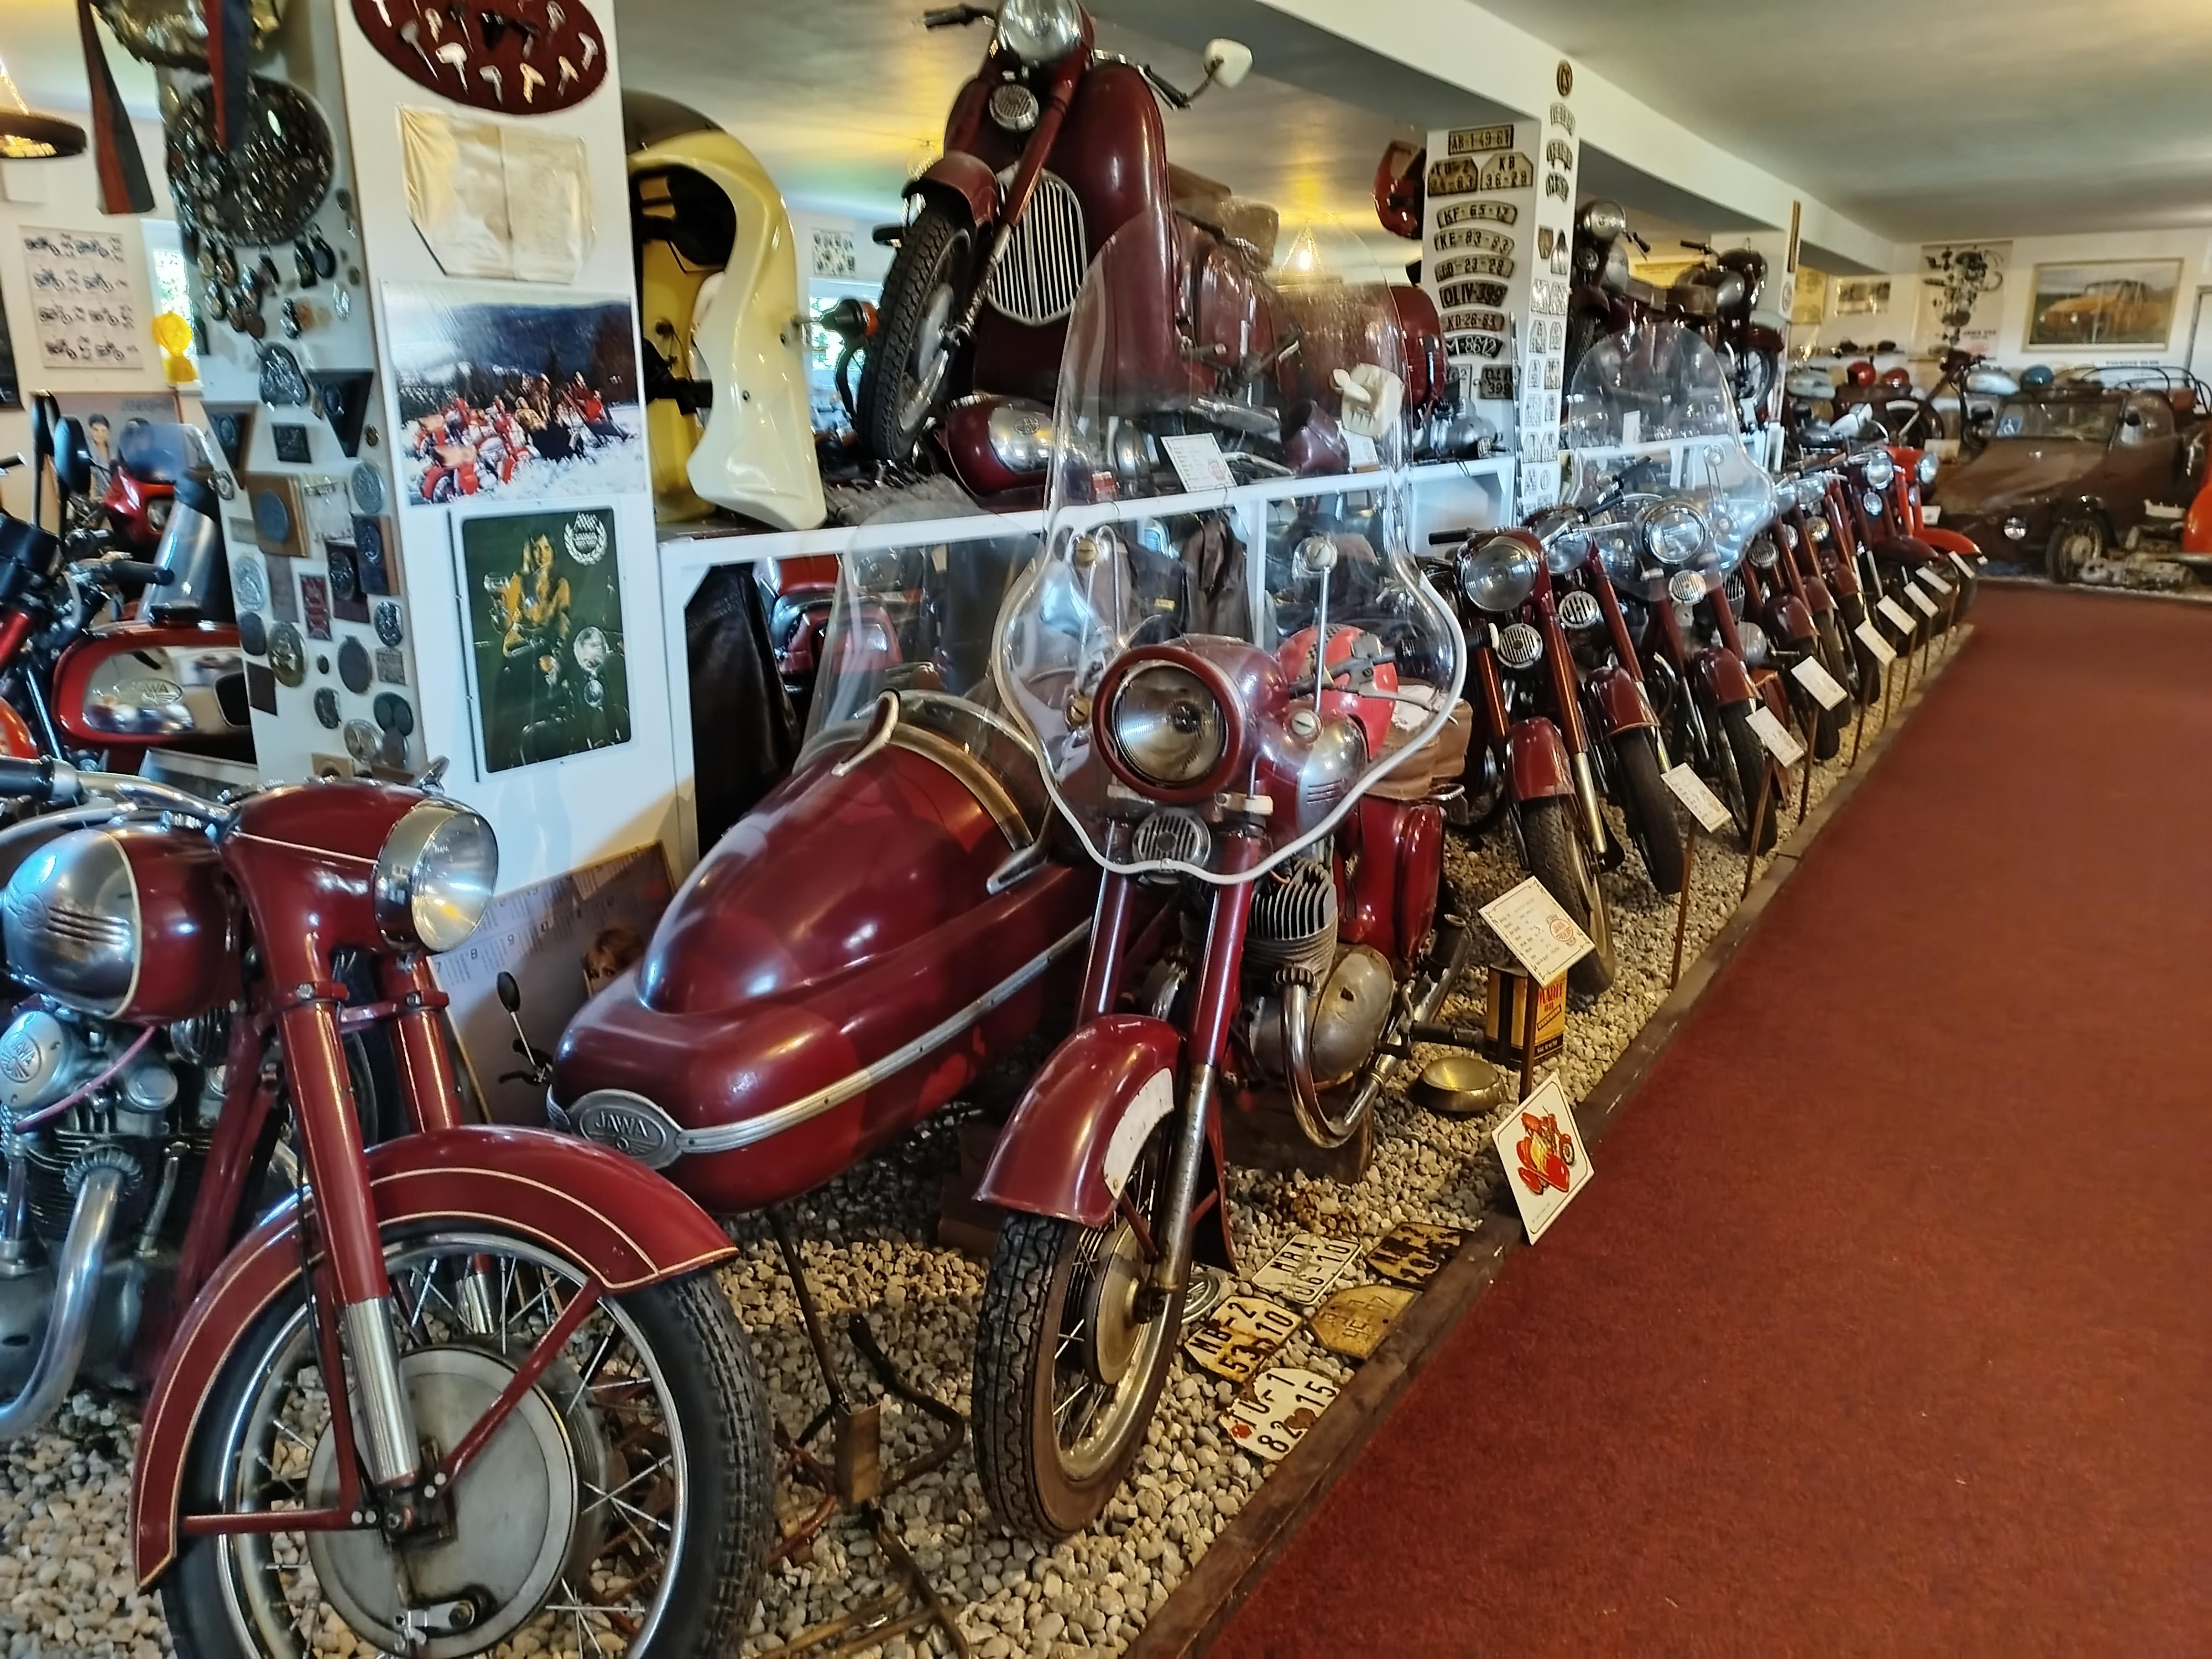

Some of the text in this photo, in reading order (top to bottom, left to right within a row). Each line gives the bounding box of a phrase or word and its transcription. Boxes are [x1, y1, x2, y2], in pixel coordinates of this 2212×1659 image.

[471, 948, 477, 959] 8
[595, 1110, 649, 1138] JAWA
[1190, 1302, 1257, 1354] MB-2
